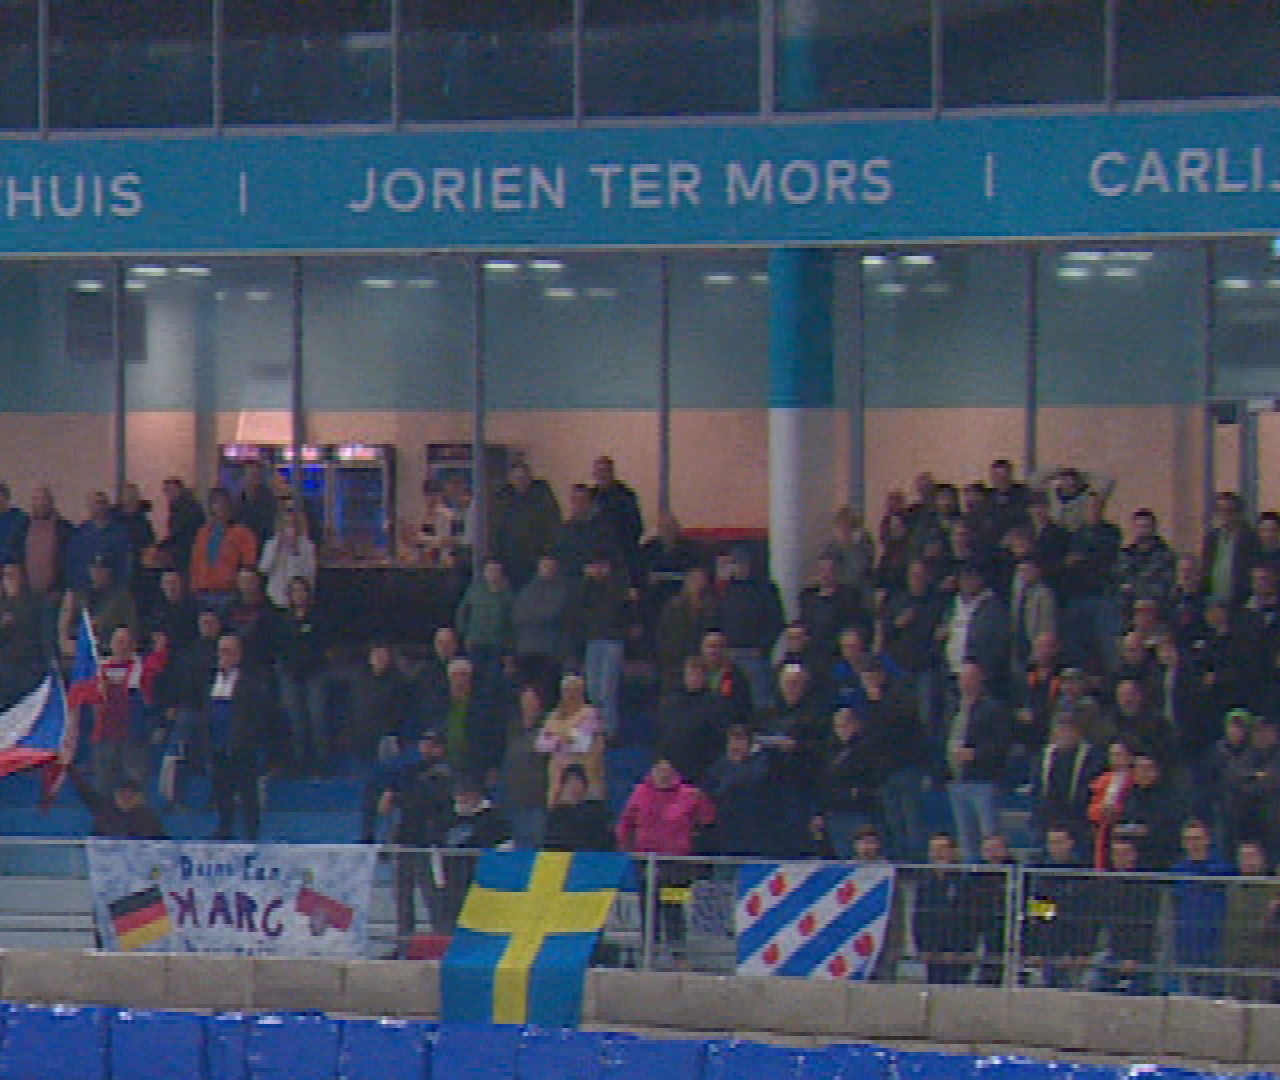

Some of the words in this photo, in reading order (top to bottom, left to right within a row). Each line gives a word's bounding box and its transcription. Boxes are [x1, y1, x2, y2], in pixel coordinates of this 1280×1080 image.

[346, 165, 568, 213] JORIEN
[587, 161, 704, 209] TER
[723, 157, 895, 207] MORS
